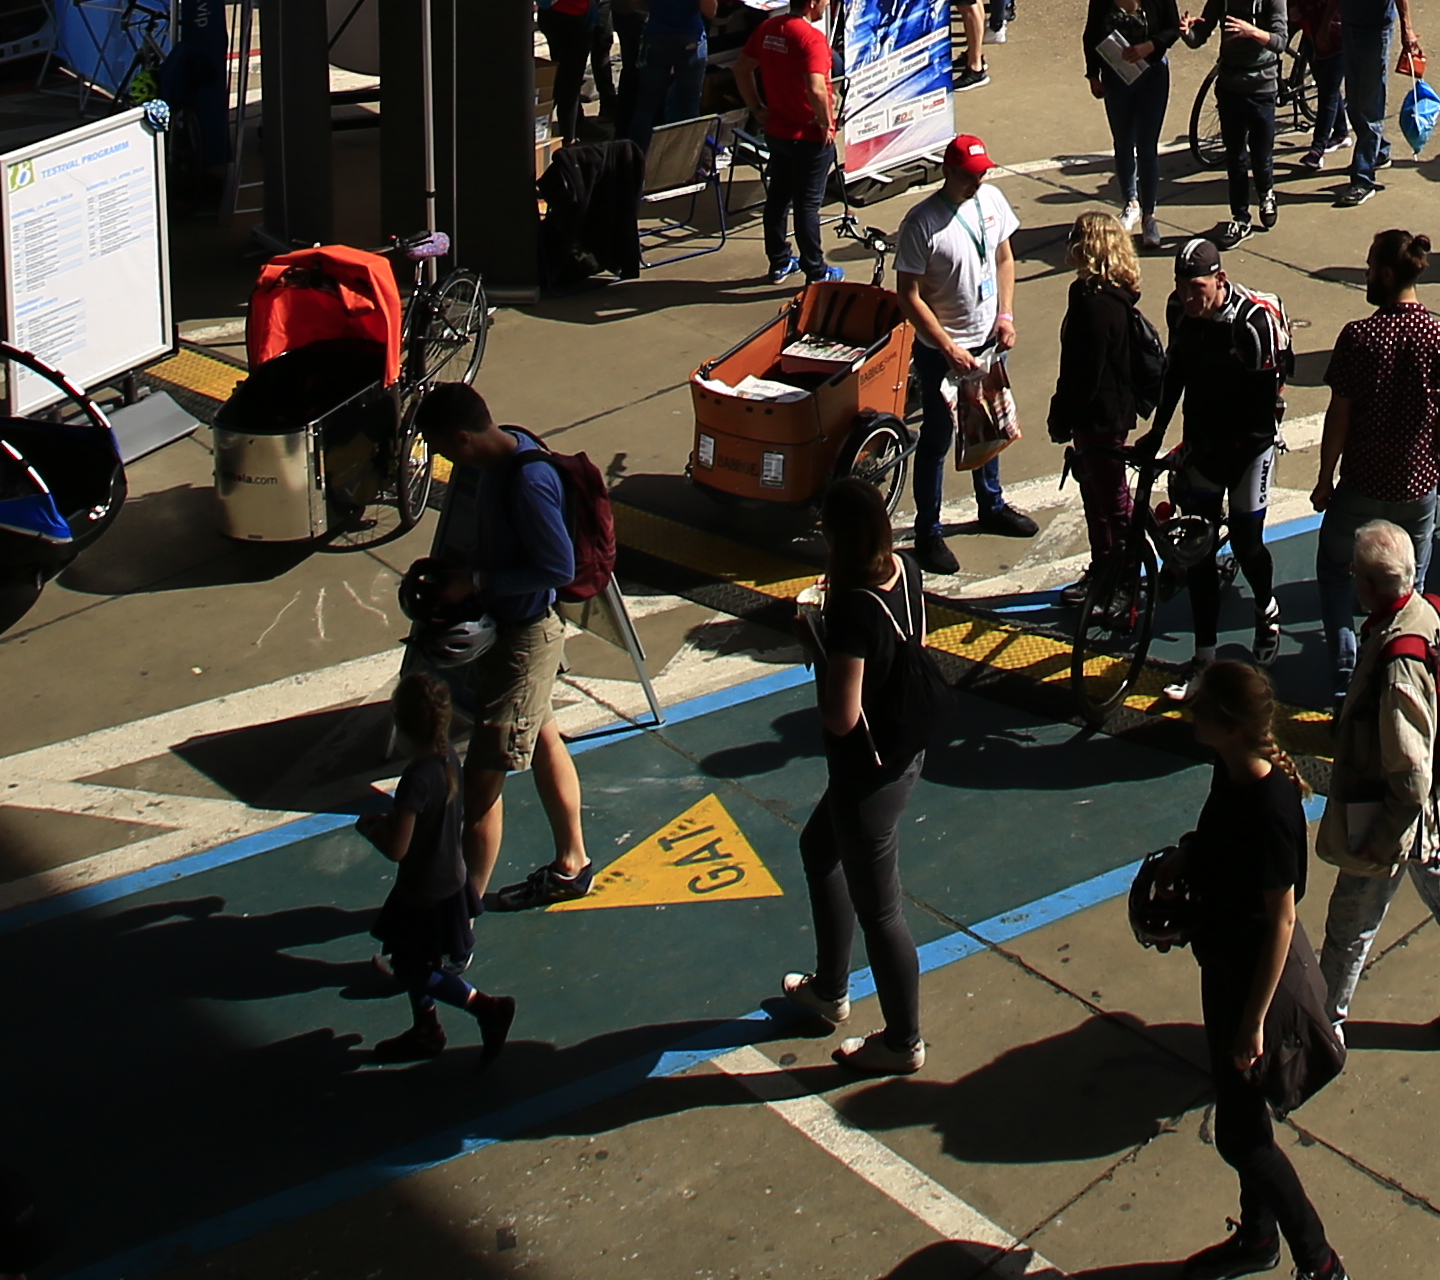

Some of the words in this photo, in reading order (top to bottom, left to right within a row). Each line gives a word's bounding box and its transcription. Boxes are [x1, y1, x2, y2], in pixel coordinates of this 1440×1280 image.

[41, 159, 80, 180] TESTIVAL
[81, 141, 130, 165] PROGRAMM
[1259, 460, 1270, 492] GIANT
